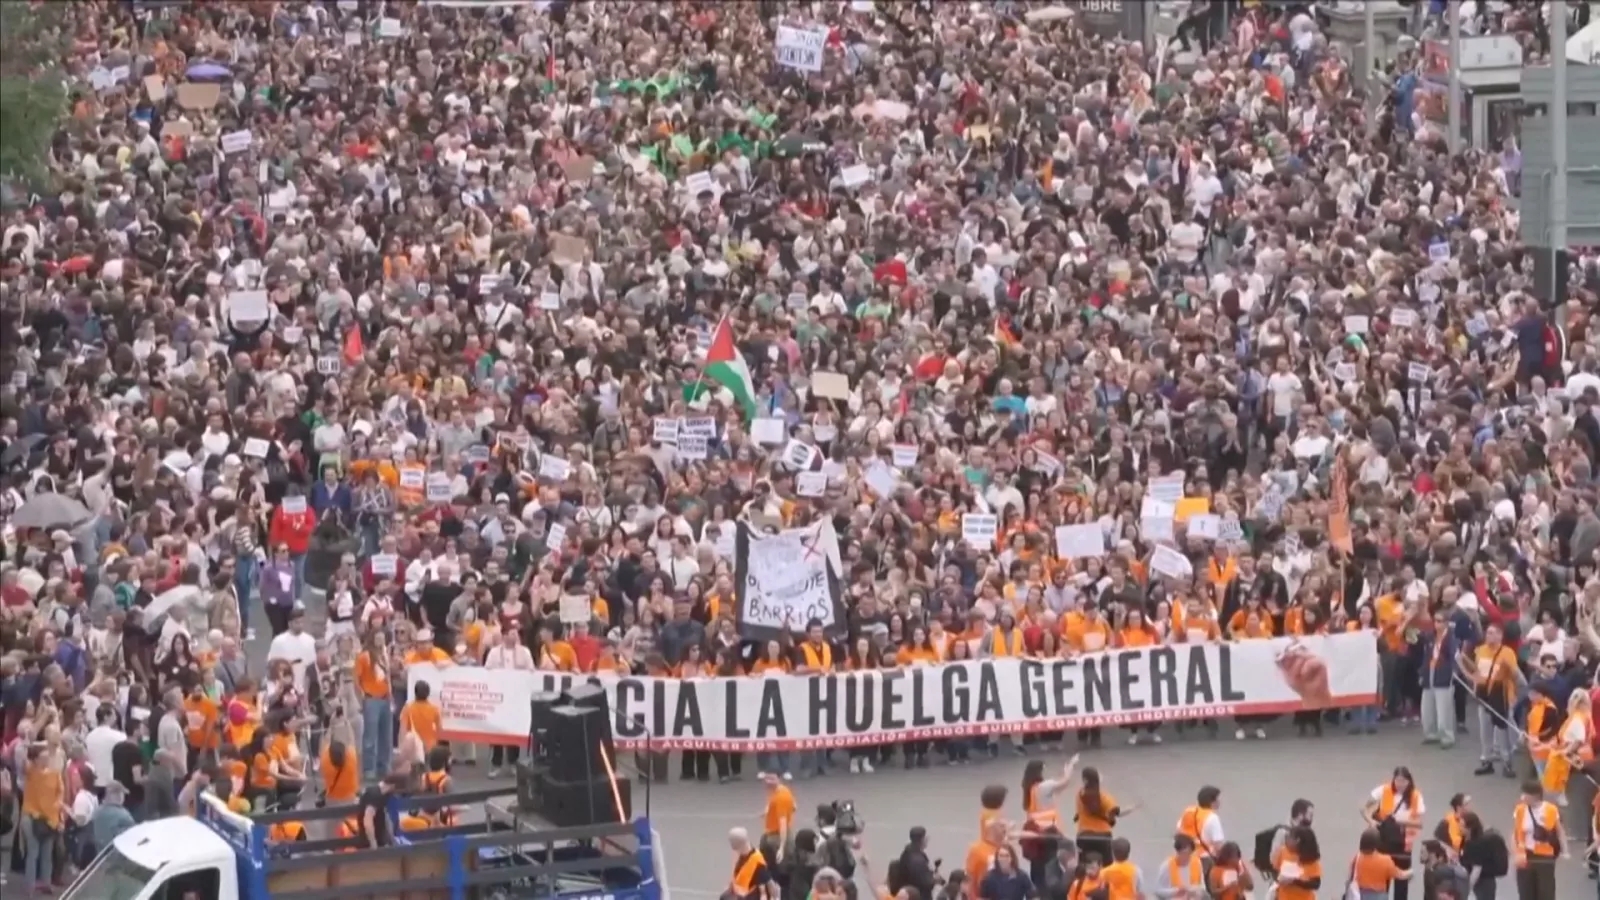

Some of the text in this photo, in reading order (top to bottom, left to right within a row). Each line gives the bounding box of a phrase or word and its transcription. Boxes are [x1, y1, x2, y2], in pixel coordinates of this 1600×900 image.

[725, 679, 787, 738] LA
[808, 668, 1004, 735] HUELGA
[1020, 644, 1245, 717] GENERAL
[662, 740, 740, 750] ALQUILER
[1046, 714, 1132, 731] CONTRATOS
[1138, 705, 1235, 720] INDEFINIDOS
